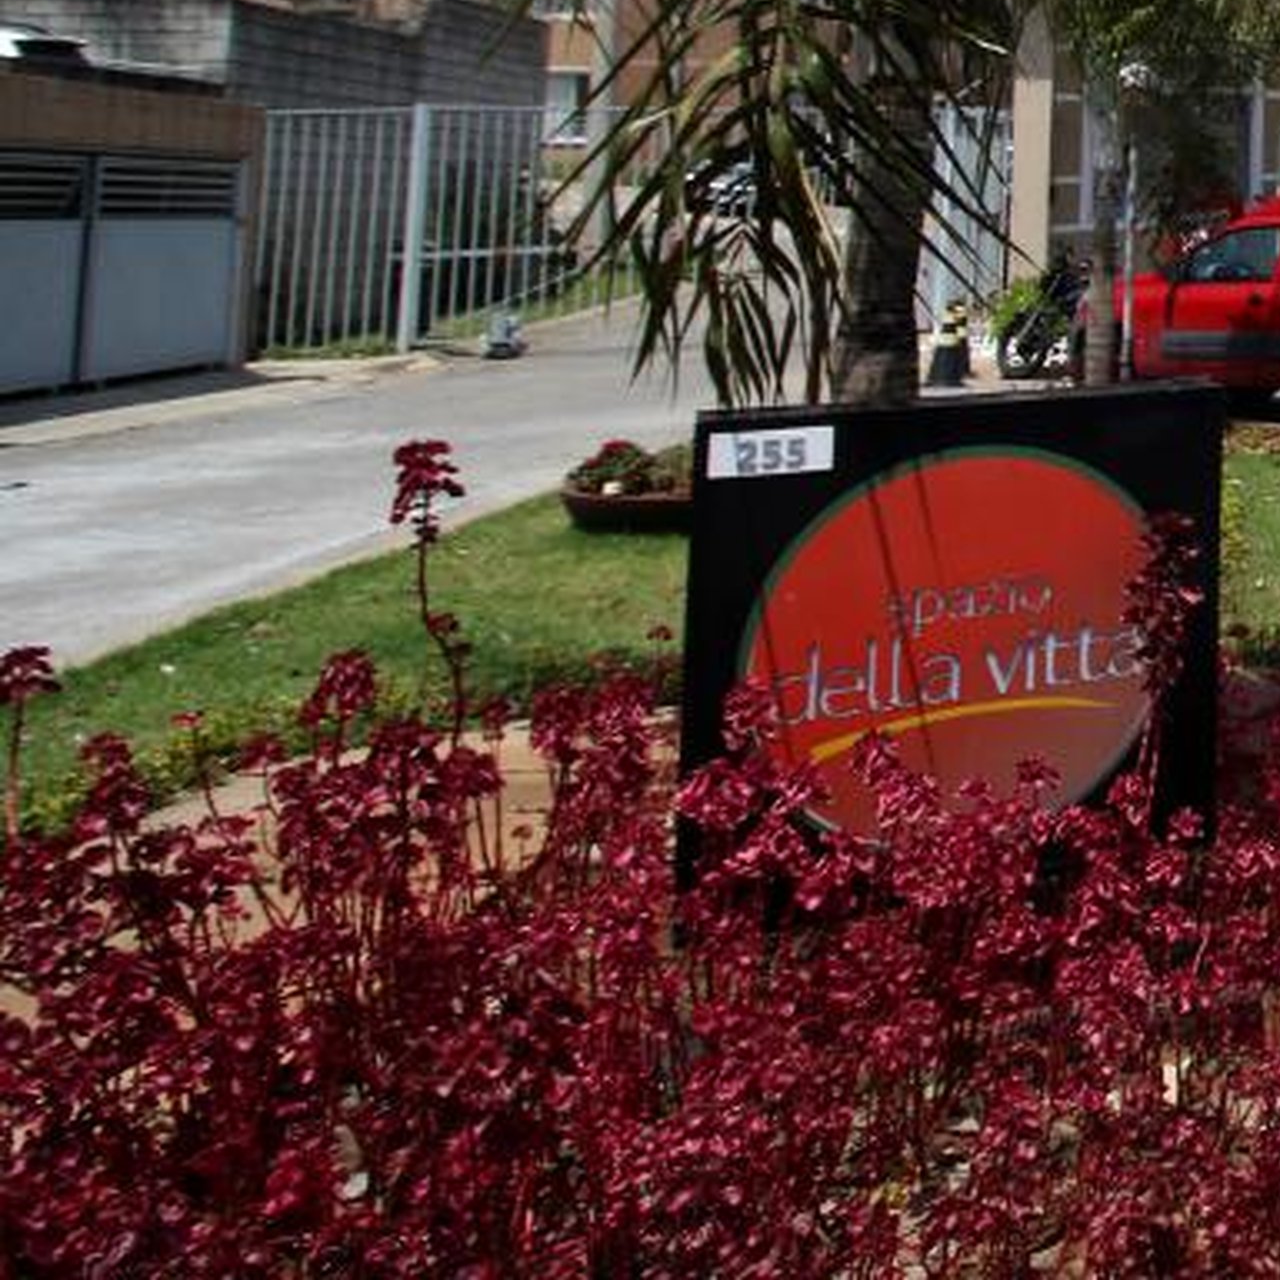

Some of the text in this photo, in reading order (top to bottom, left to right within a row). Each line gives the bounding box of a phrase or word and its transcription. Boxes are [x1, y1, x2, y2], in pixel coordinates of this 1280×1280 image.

[734, 437, 807, 474] 255
[887, 579, 1054, 637] spazio
[768, 626, 1148, 724] della vitta
